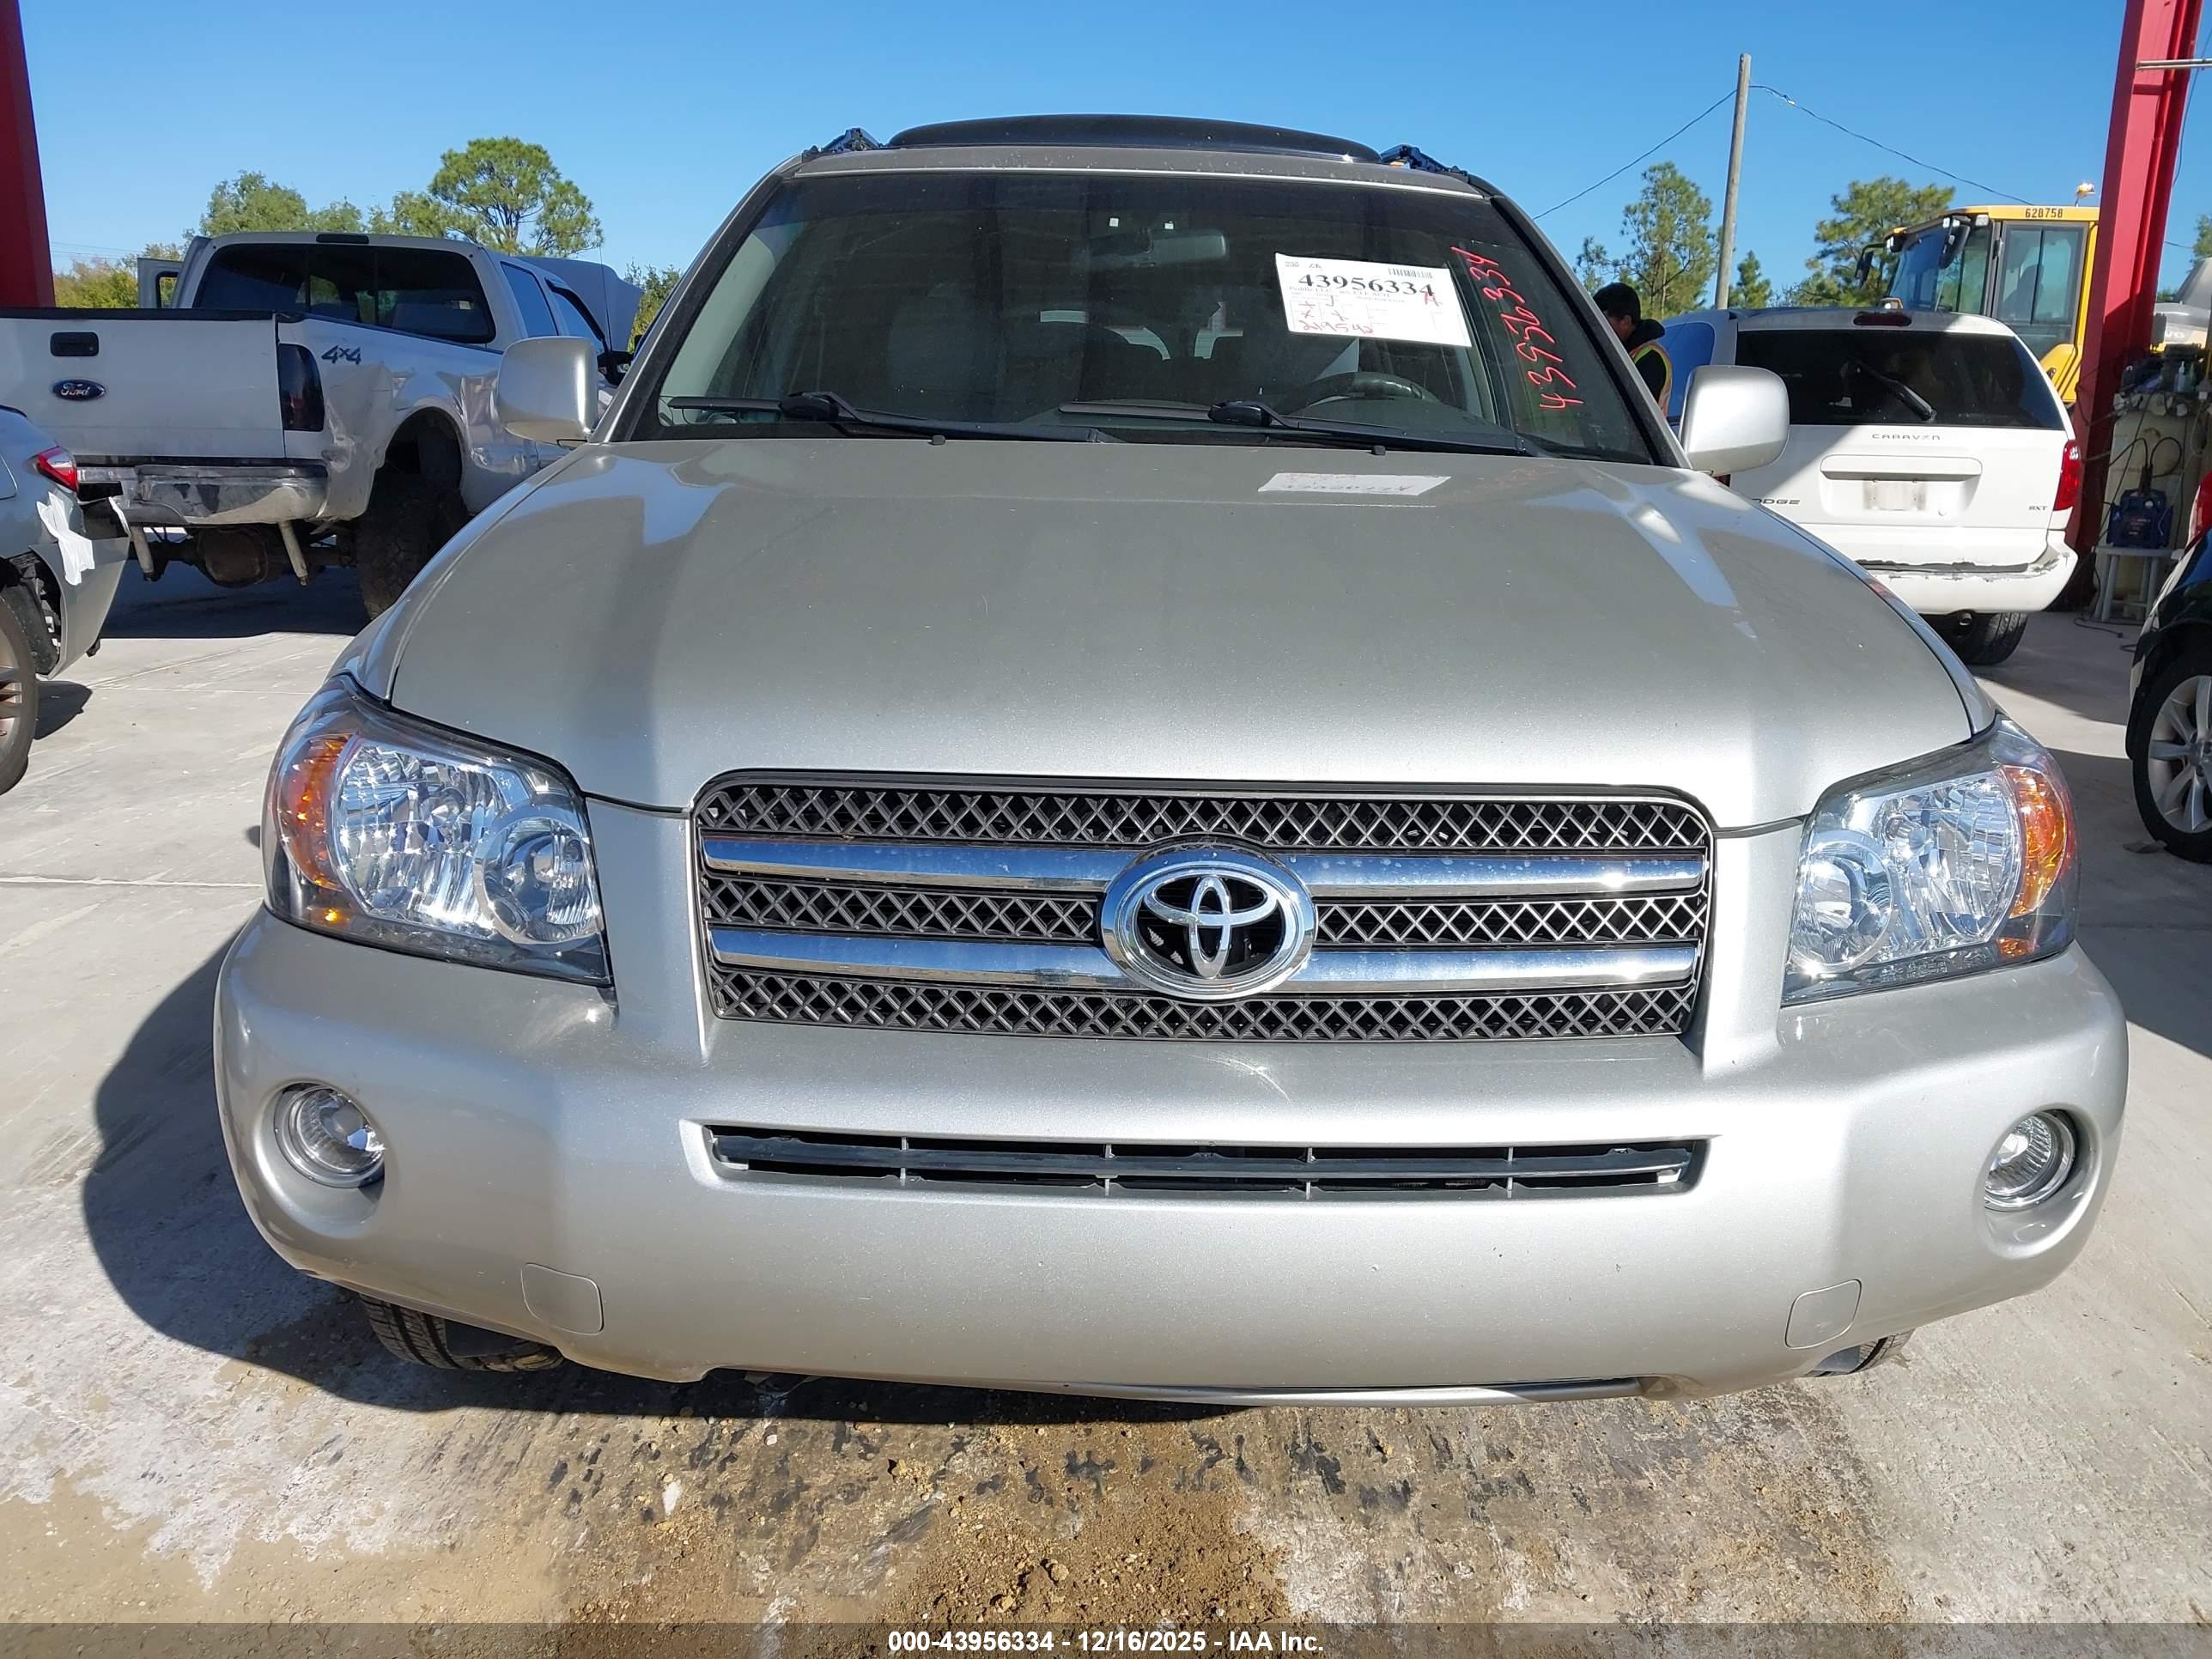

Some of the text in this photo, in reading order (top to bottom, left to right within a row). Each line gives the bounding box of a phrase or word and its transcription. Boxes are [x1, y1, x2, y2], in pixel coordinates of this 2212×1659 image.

[2025, 207, 2063, 218] 628758
[1297, 274, 1435, 297] 43956334
[1450, 246, 1584, 409] 43956334
